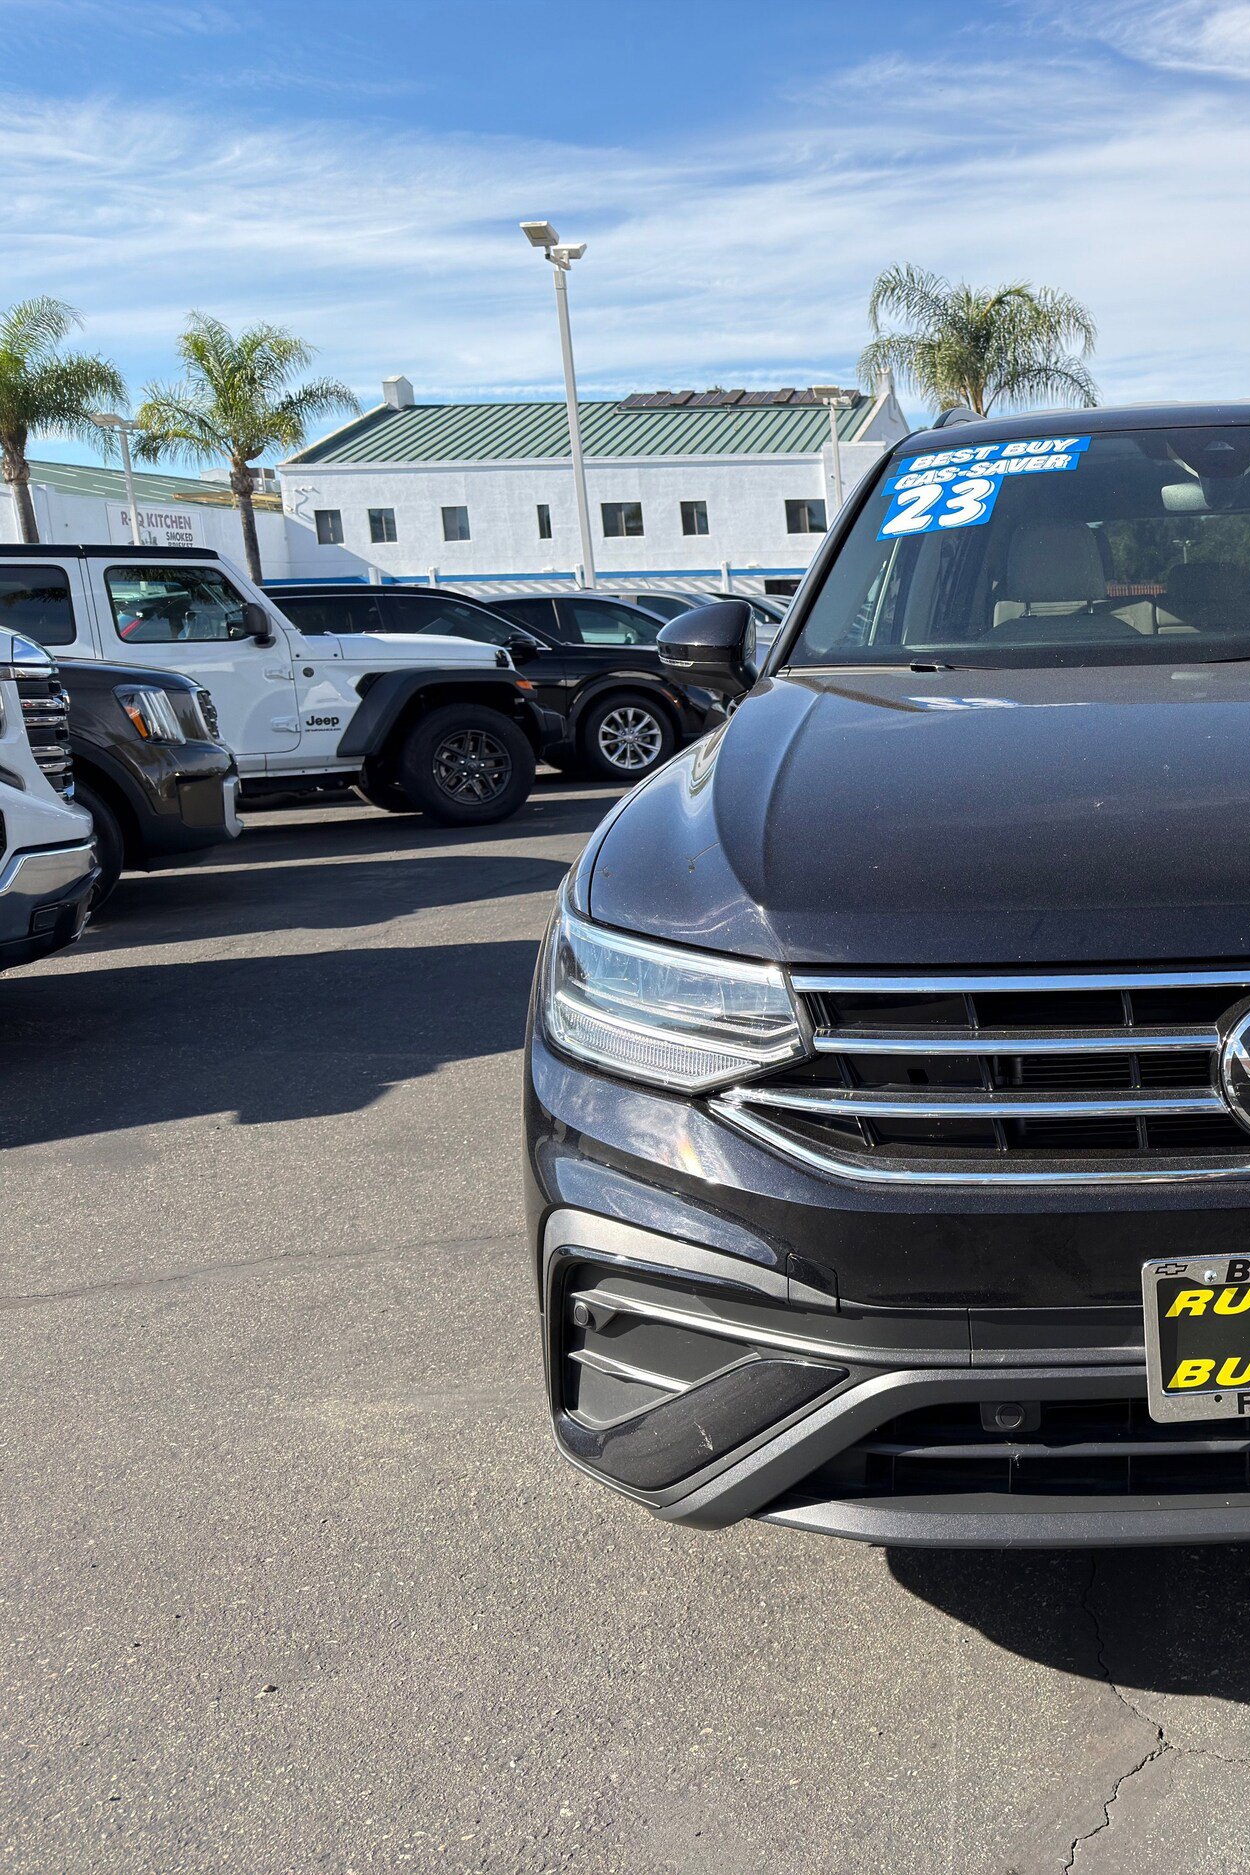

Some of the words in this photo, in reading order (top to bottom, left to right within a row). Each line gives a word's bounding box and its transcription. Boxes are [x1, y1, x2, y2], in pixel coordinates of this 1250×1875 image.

[908, 445, 1000, 472] BEST
[1001, 438, 1080, 457] BUY
[894, 453, 1073, 491] GAS-SAVER
[882, 478, 995, 536] 23
[146, 512, 192, 530] KITCHEN
[166, 531, 193, 542] SMOKED
[306, 715, 340, 727] Jeep
